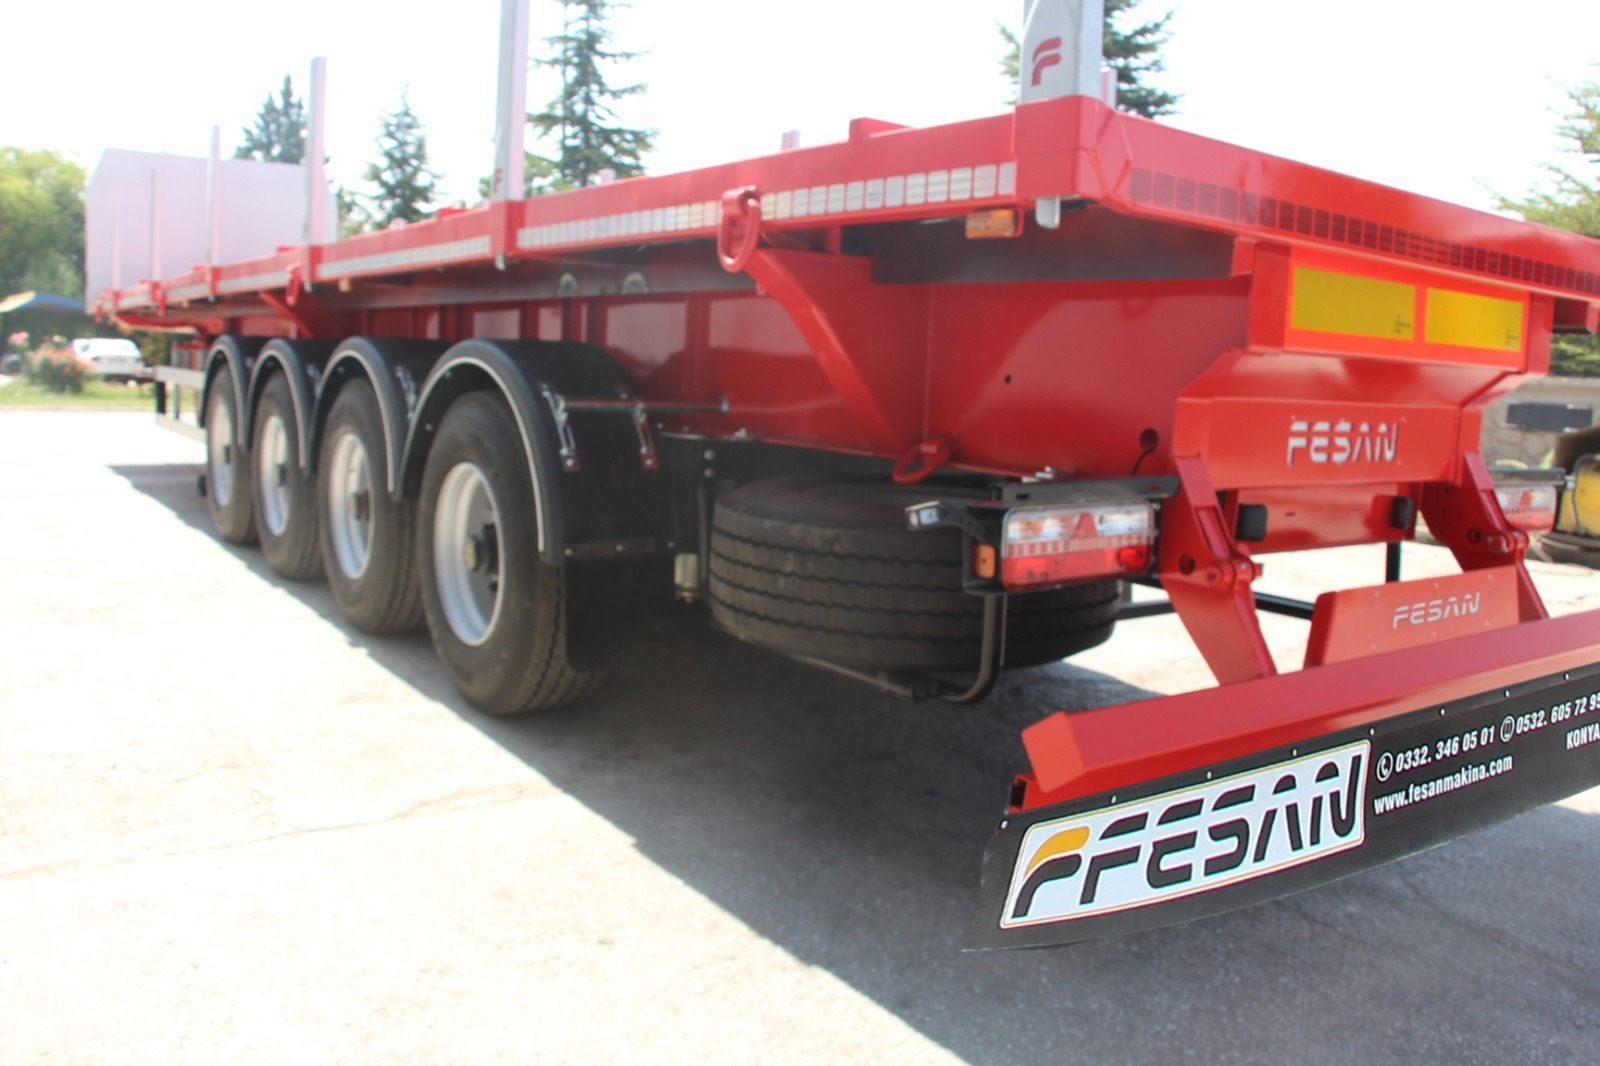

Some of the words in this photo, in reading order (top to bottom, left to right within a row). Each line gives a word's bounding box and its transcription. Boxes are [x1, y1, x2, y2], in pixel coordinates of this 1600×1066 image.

[1286, 421, 1398, 466] FESAN
[1392, 592, 1480, 629] FESAN
[1395, 745, 1432, 772] 0332.
[1435, 736, 1460, 760] 346
[1462, 730, 1478, 752] 05
[1480, 725, 1495, 746] 01
[1516, 709, 1548, 734] 0532.
[1551, 702, 1572, 724] 605
[1574, 696, 1588, 716] 72
[1566, 723, 1600, 750] KONYA
[1373, 755, 1513, 815] www.fesanmakina.com
